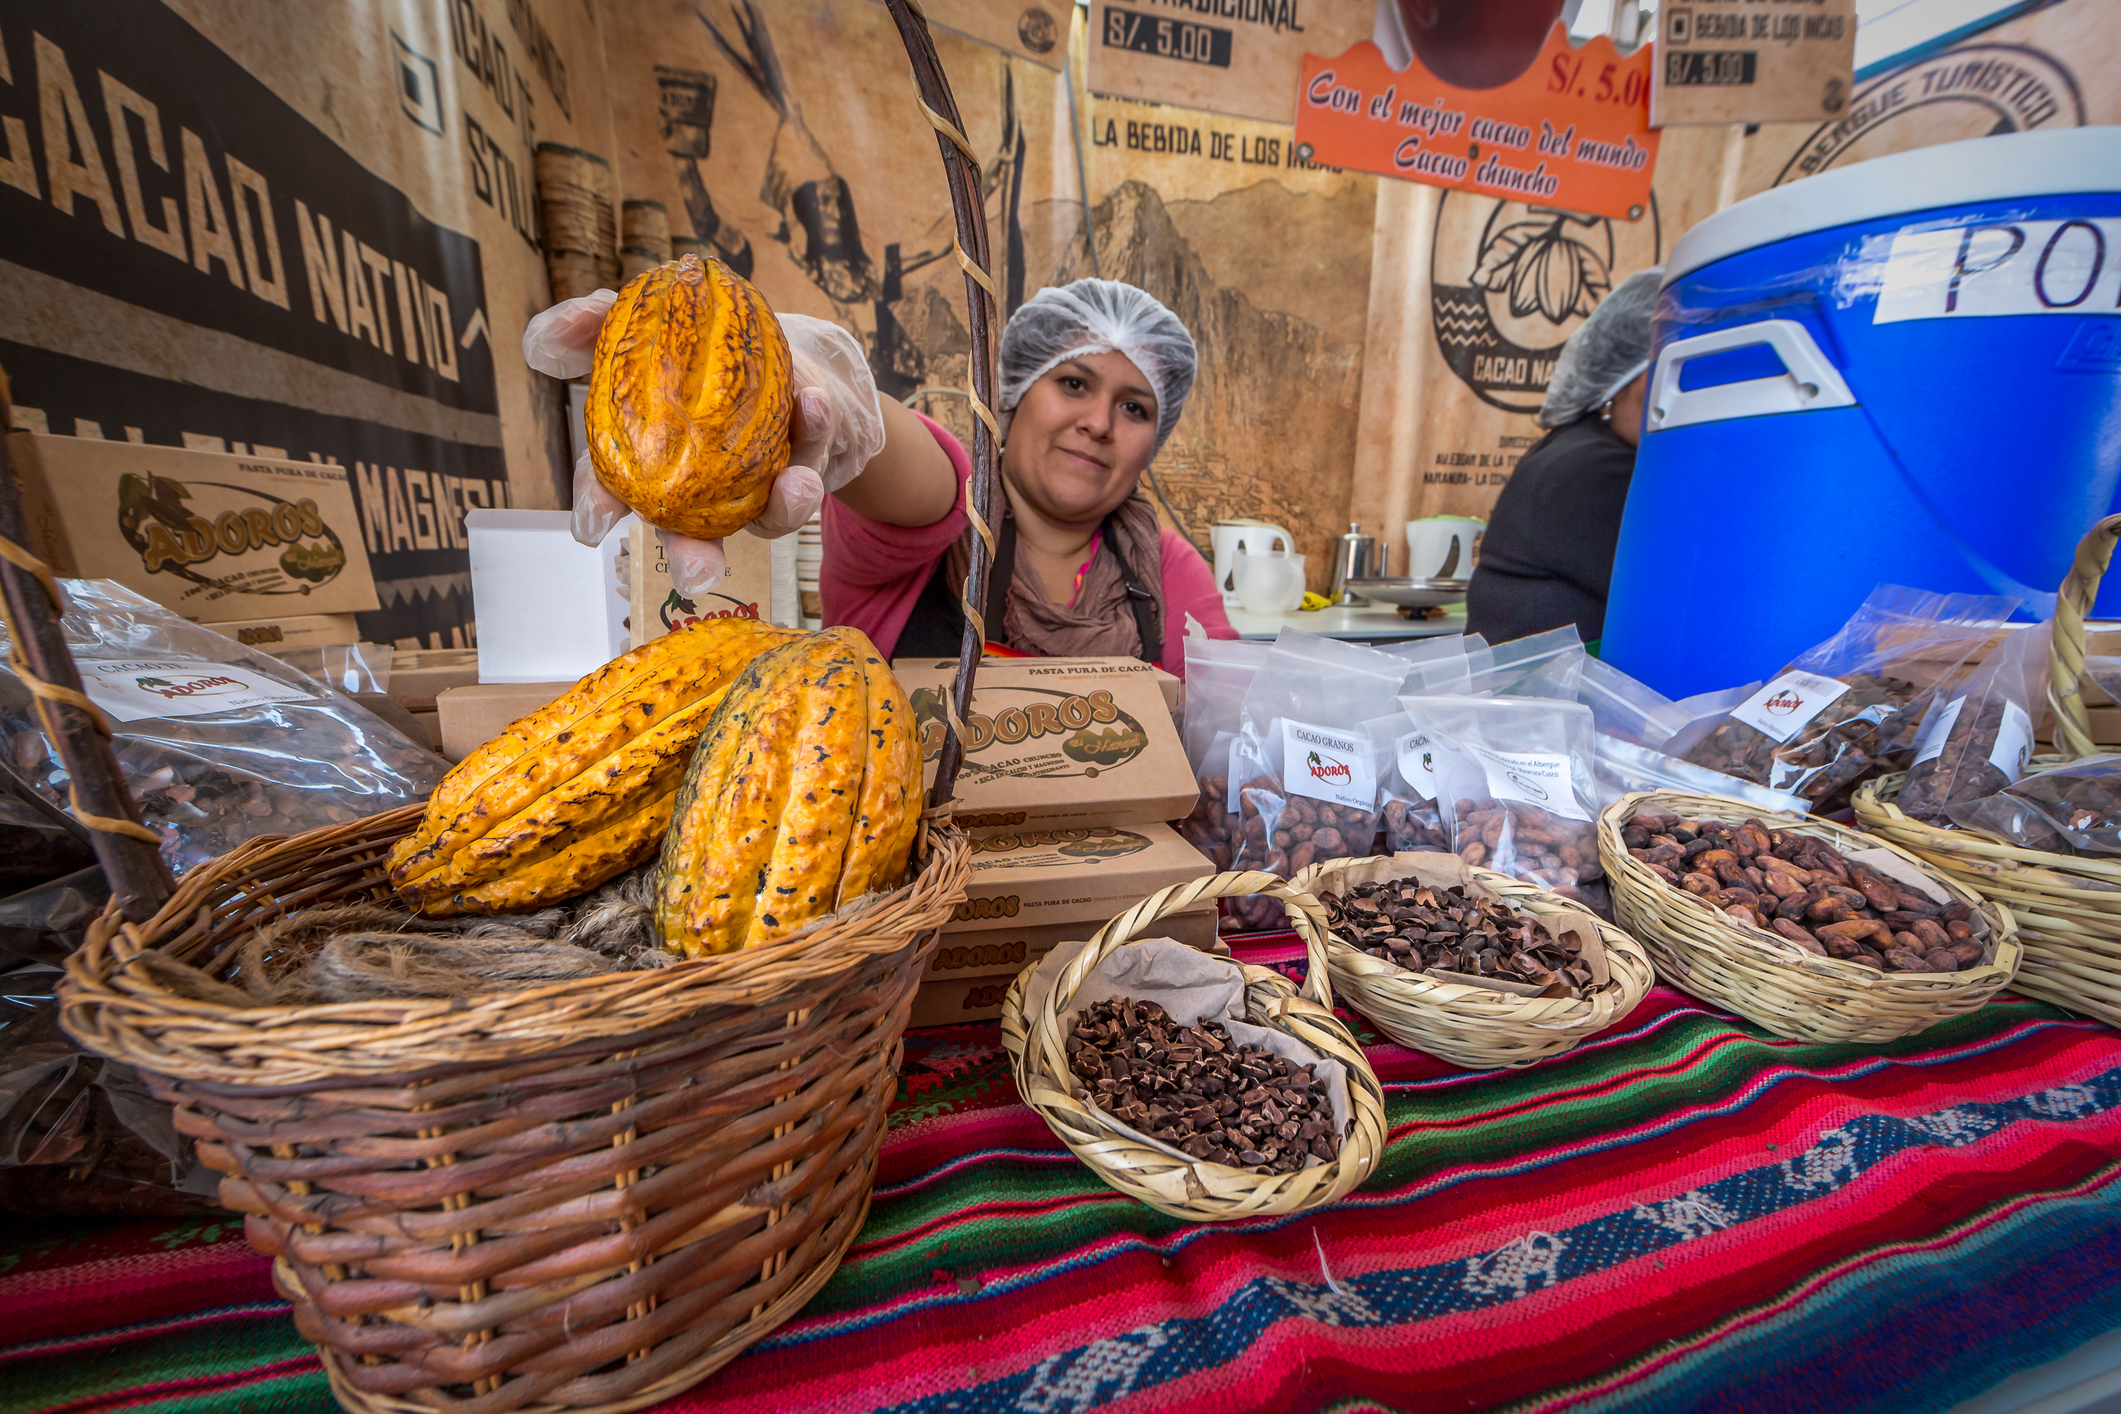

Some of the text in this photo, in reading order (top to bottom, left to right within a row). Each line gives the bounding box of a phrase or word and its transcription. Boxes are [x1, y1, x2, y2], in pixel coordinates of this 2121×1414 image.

[1150, 0, 1304, 33] DICIONAL
[1157, 20, 1212, 63] 5.00
[1702, 53, 1744, 84] 5.00
[1308, 70, 1648, 171] Con el mejor cacao del mundo
[1794, 79, 1911, 177] BERGUE
[1092, 117, 1118, 148] LA
[1126, 120, 1203, 157] BEBIDA
[1210, 131, 1236, 163] DE
[1241, 135, 1281, 166] LOS
[1395, 136, 1468, 180] Cacao
[1476, 153, 1560, 198] chuncho
[1473, 354, 1529, 384] CACAO
[144, 497, 325, 574] ADOROS
[1296, 729, 1355, 752] CACAO GRANOS
[1409, 735, 1431, 750] CACA
[980, 758, 1021, 774] CACAO
[1023, 752, 1063, 763] CHUNCHO
[1311, 764, 1350, 777] ADOROS
[1533, 760, 1560, 770] Albergue
[932, 941, 1028, 971] ADOROS
